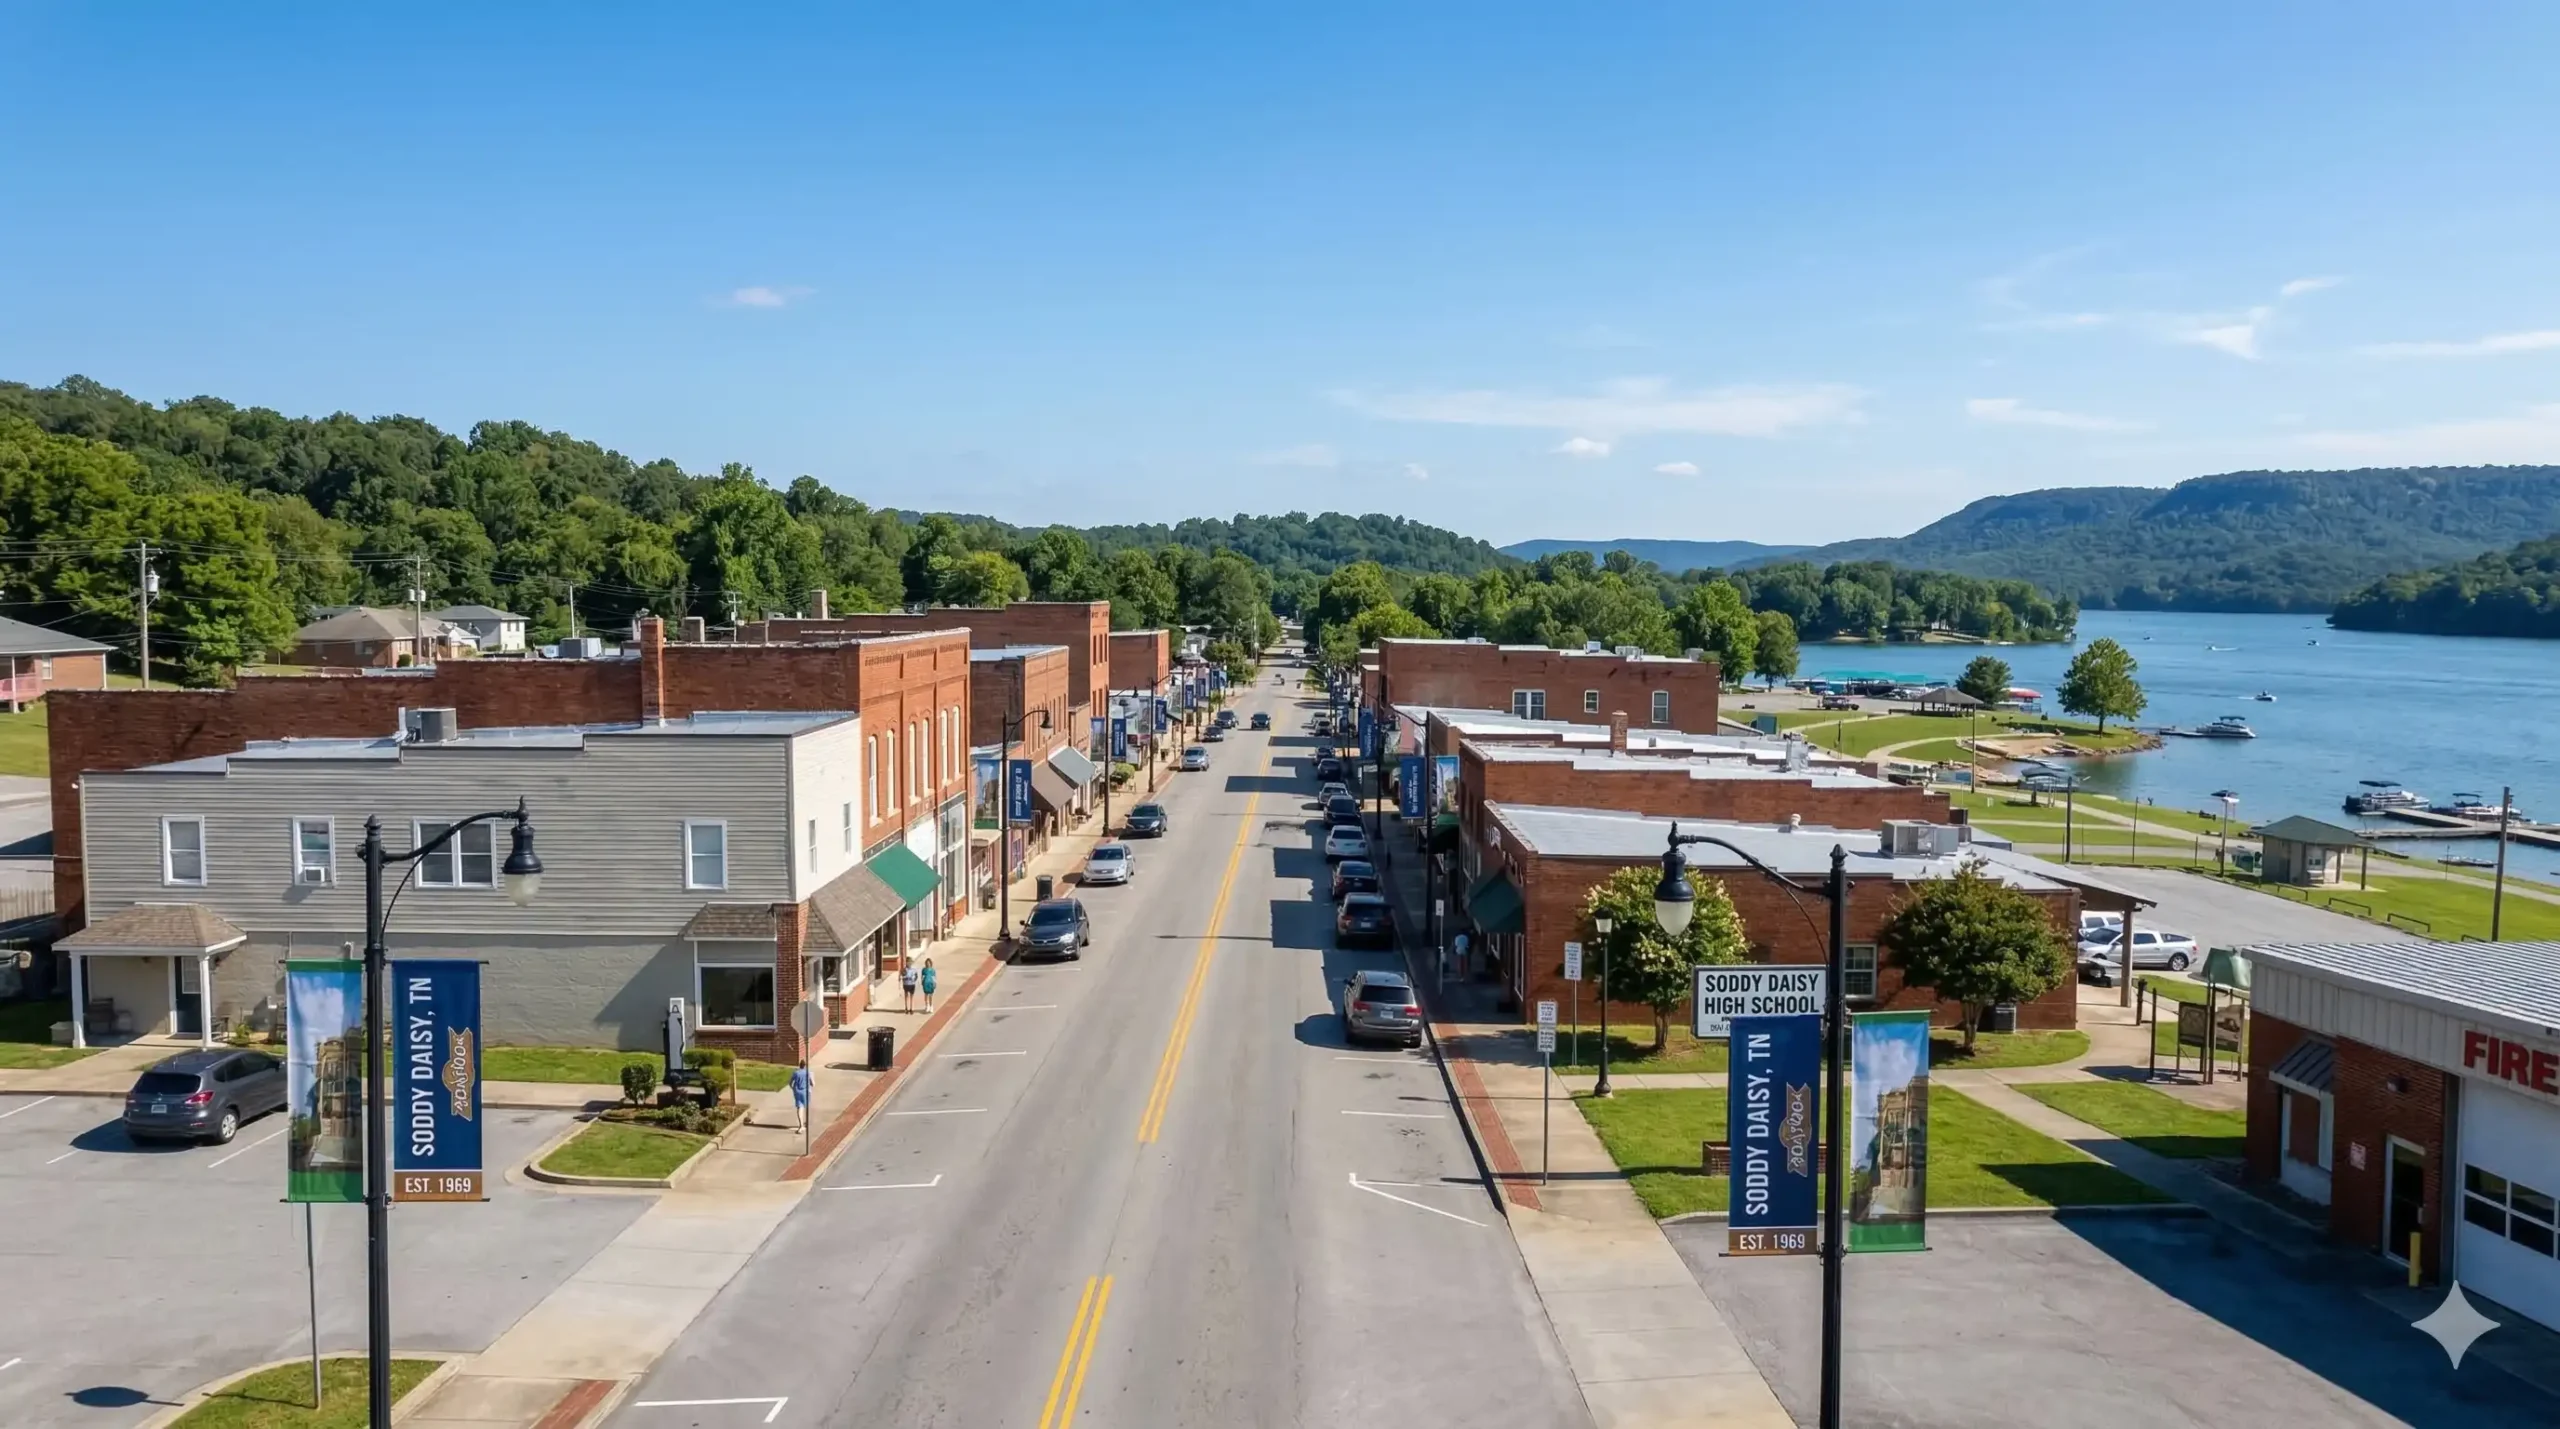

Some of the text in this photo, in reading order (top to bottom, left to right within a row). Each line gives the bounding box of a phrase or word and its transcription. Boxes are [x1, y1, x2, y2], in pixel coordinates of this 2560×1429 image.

[1705, 973, 1819, 993] SODDY DAISY
[1704, 995, 1820, 1015] HIGH SCHOOL
[409, 977, 436, 1156] SODDY DAISY, TN
[2463, 1029, 2560, 1096] FIRE
[1745, 1033, 1774, 1215] SODDY DAISY, TN
[405, 1177, 472, 1193] EST. 1969
[1739, 1233, 1806, 1250] EST. 1969
